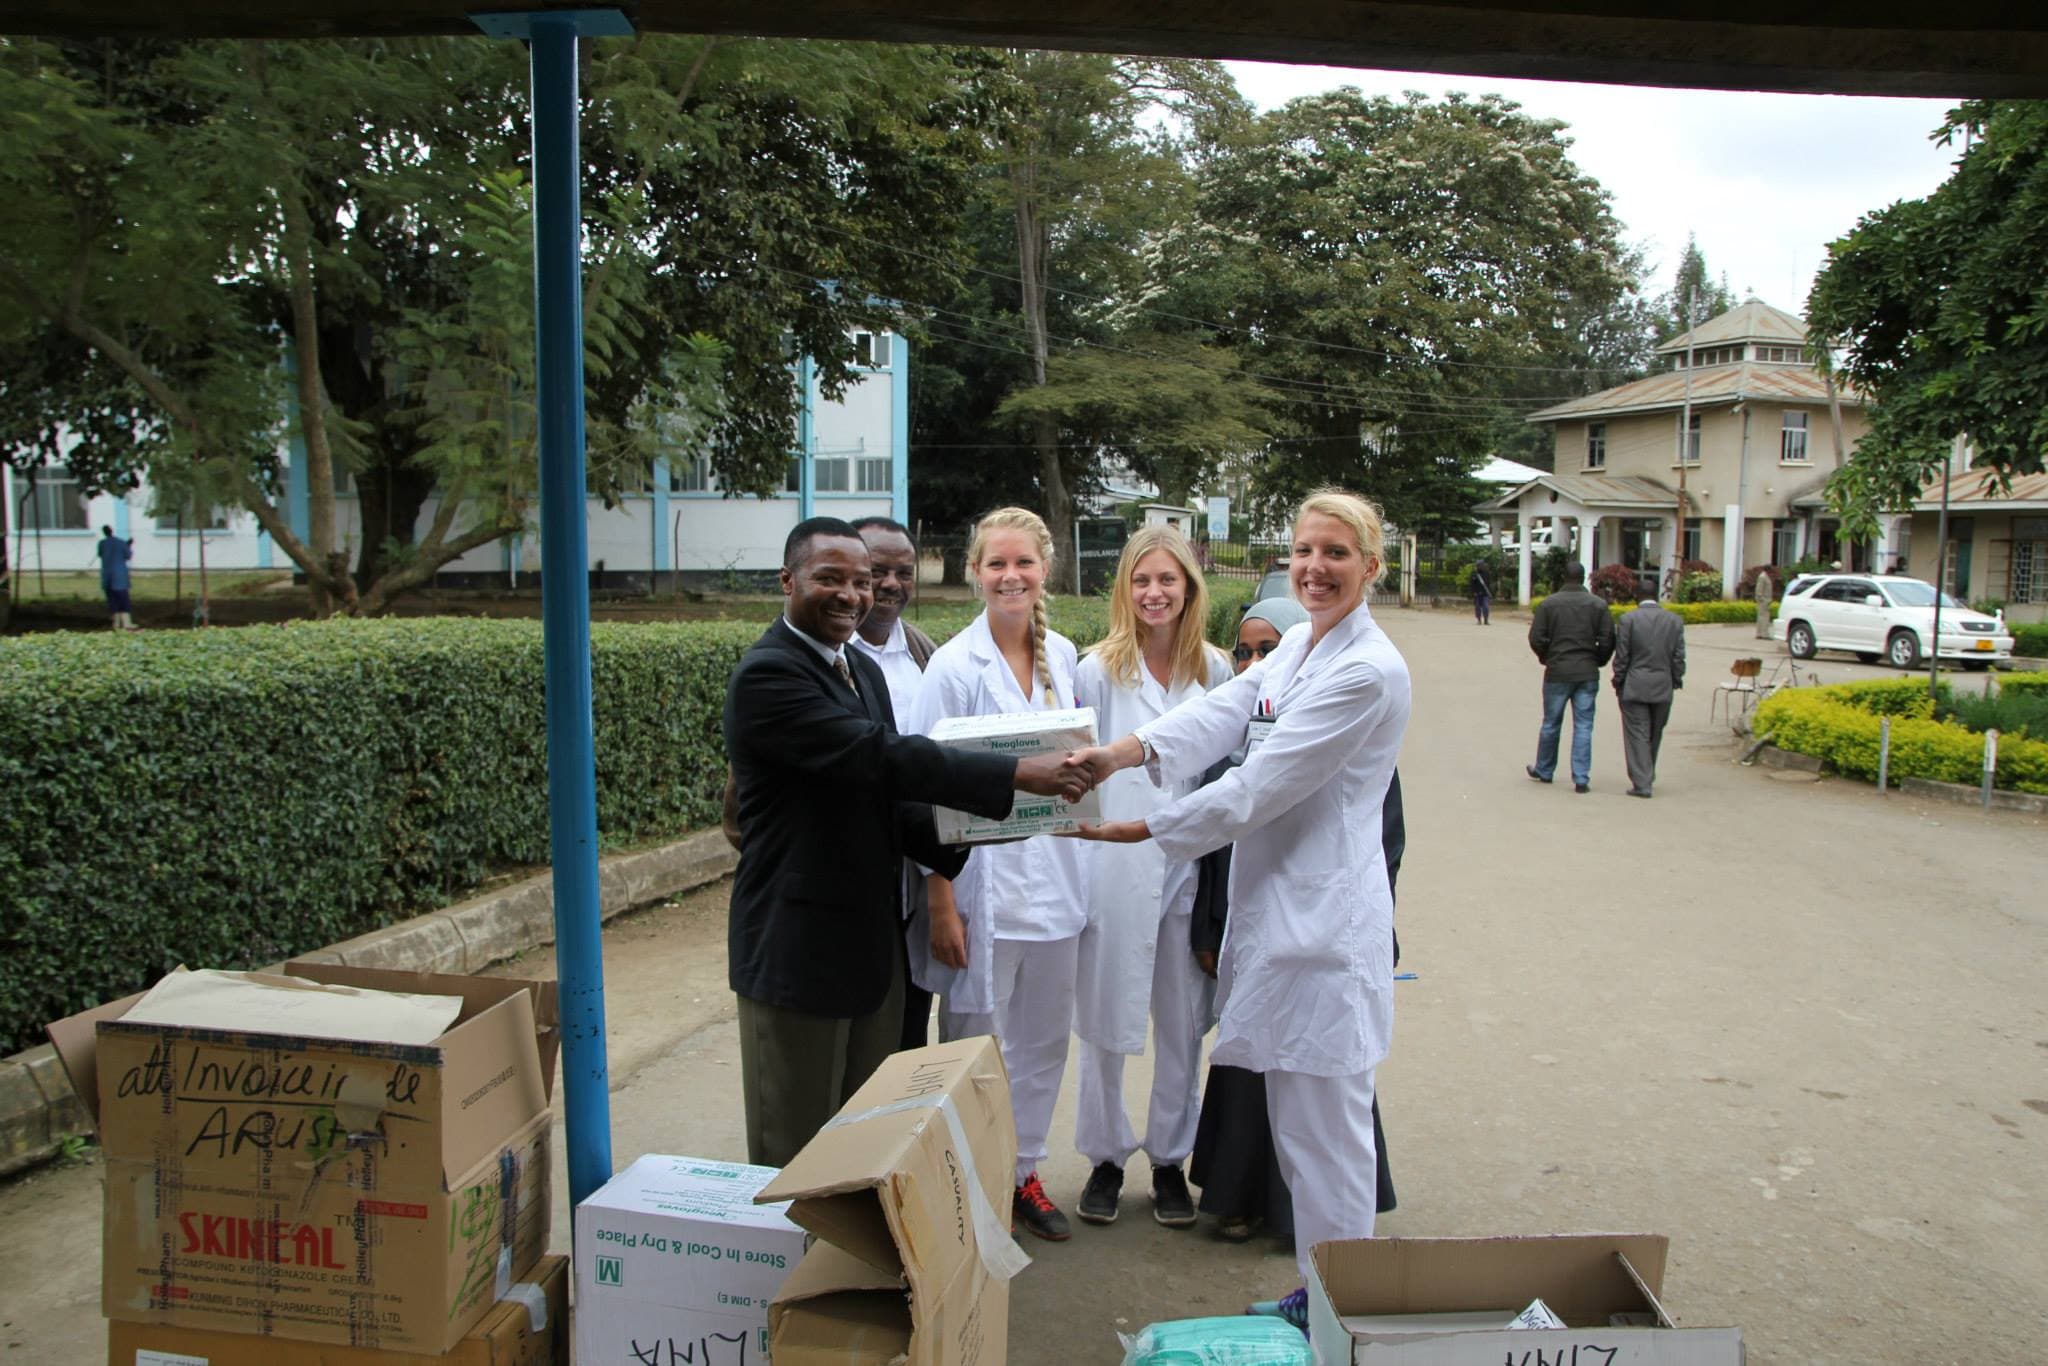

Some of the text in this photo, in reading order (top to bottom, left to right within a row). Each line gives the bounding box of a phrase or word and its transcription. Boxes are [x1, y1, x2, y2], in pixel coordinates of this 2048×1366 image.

[991, 738, 1041, 750] Neogloves
[655, 1203, 728, 1218] Neogloves
[178, 1211, 347, 1270] SKINEAL
[596, 1229, 787, 1269] Store In Cool & Dry Place
[599, 1258, 620, 1283] M
[717, 1291, 729, 1304] E)
[731, 1294, 751, 1307] DIM
